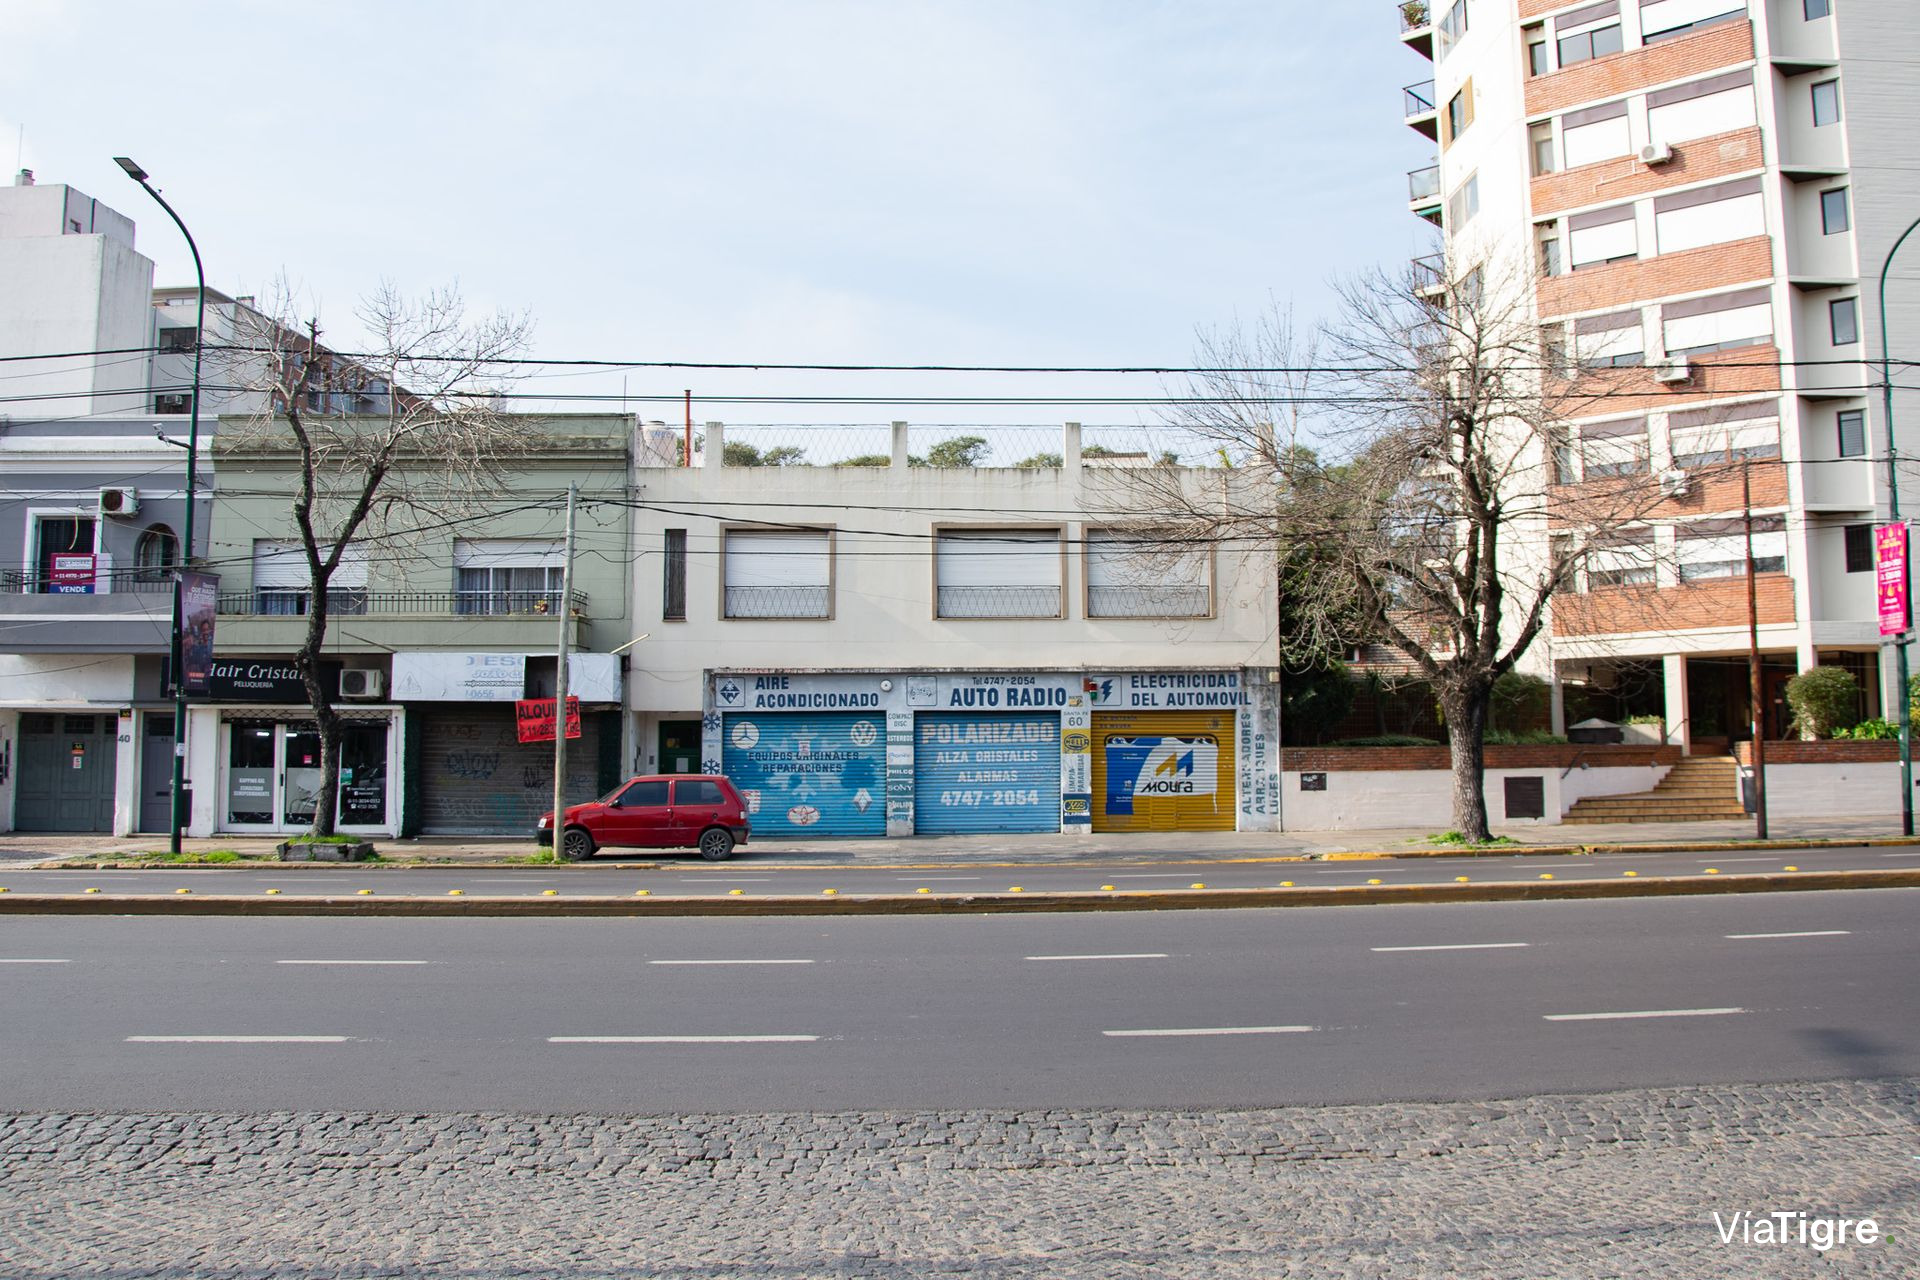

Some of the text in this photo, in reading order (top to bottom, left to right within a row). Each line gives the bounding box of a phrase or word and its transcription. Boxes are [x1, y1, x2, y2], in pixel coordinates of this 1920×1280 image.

[755, 676, 790, 690] AIRE
[984, 676, 1036, 686] 4747-2054
[1131, 674, 1238, 688] ELECTRICIDAD
[755, 692, 879, 708] ACONDICIONADO
[950, 687, 999, 707] AUTO
[1006, 687, 1067, 706] RADIO
[1131, 691, 1252, 706] DEL AUTOMOVIL
[518, 701, 579, 720] ALQUIER
[888, 712, 912, 720] COMPACT
[893, 720, 908, 728] DISC
[1068, 716, 1083, 727] 60
[118, 735, 131, 743] 40
[922, 722, 1055, 745] POLARIZADO
[749, 752, 860, 761] EQUIPOS ORIGINALES
[936, 750, 1039, 763] ALZA CRISTALES
[1241, 712, 1252, 815] ALTERADORES
[762, 763, 844, 773] REPARACIONES
[1255, 733, 1266, 815] ARRQUES
[957, 770, 1019, 783] ALARMAS
[940, 789, 1040, 806] 4747-2054
[1269, 773, 1279, 815] LUCES
